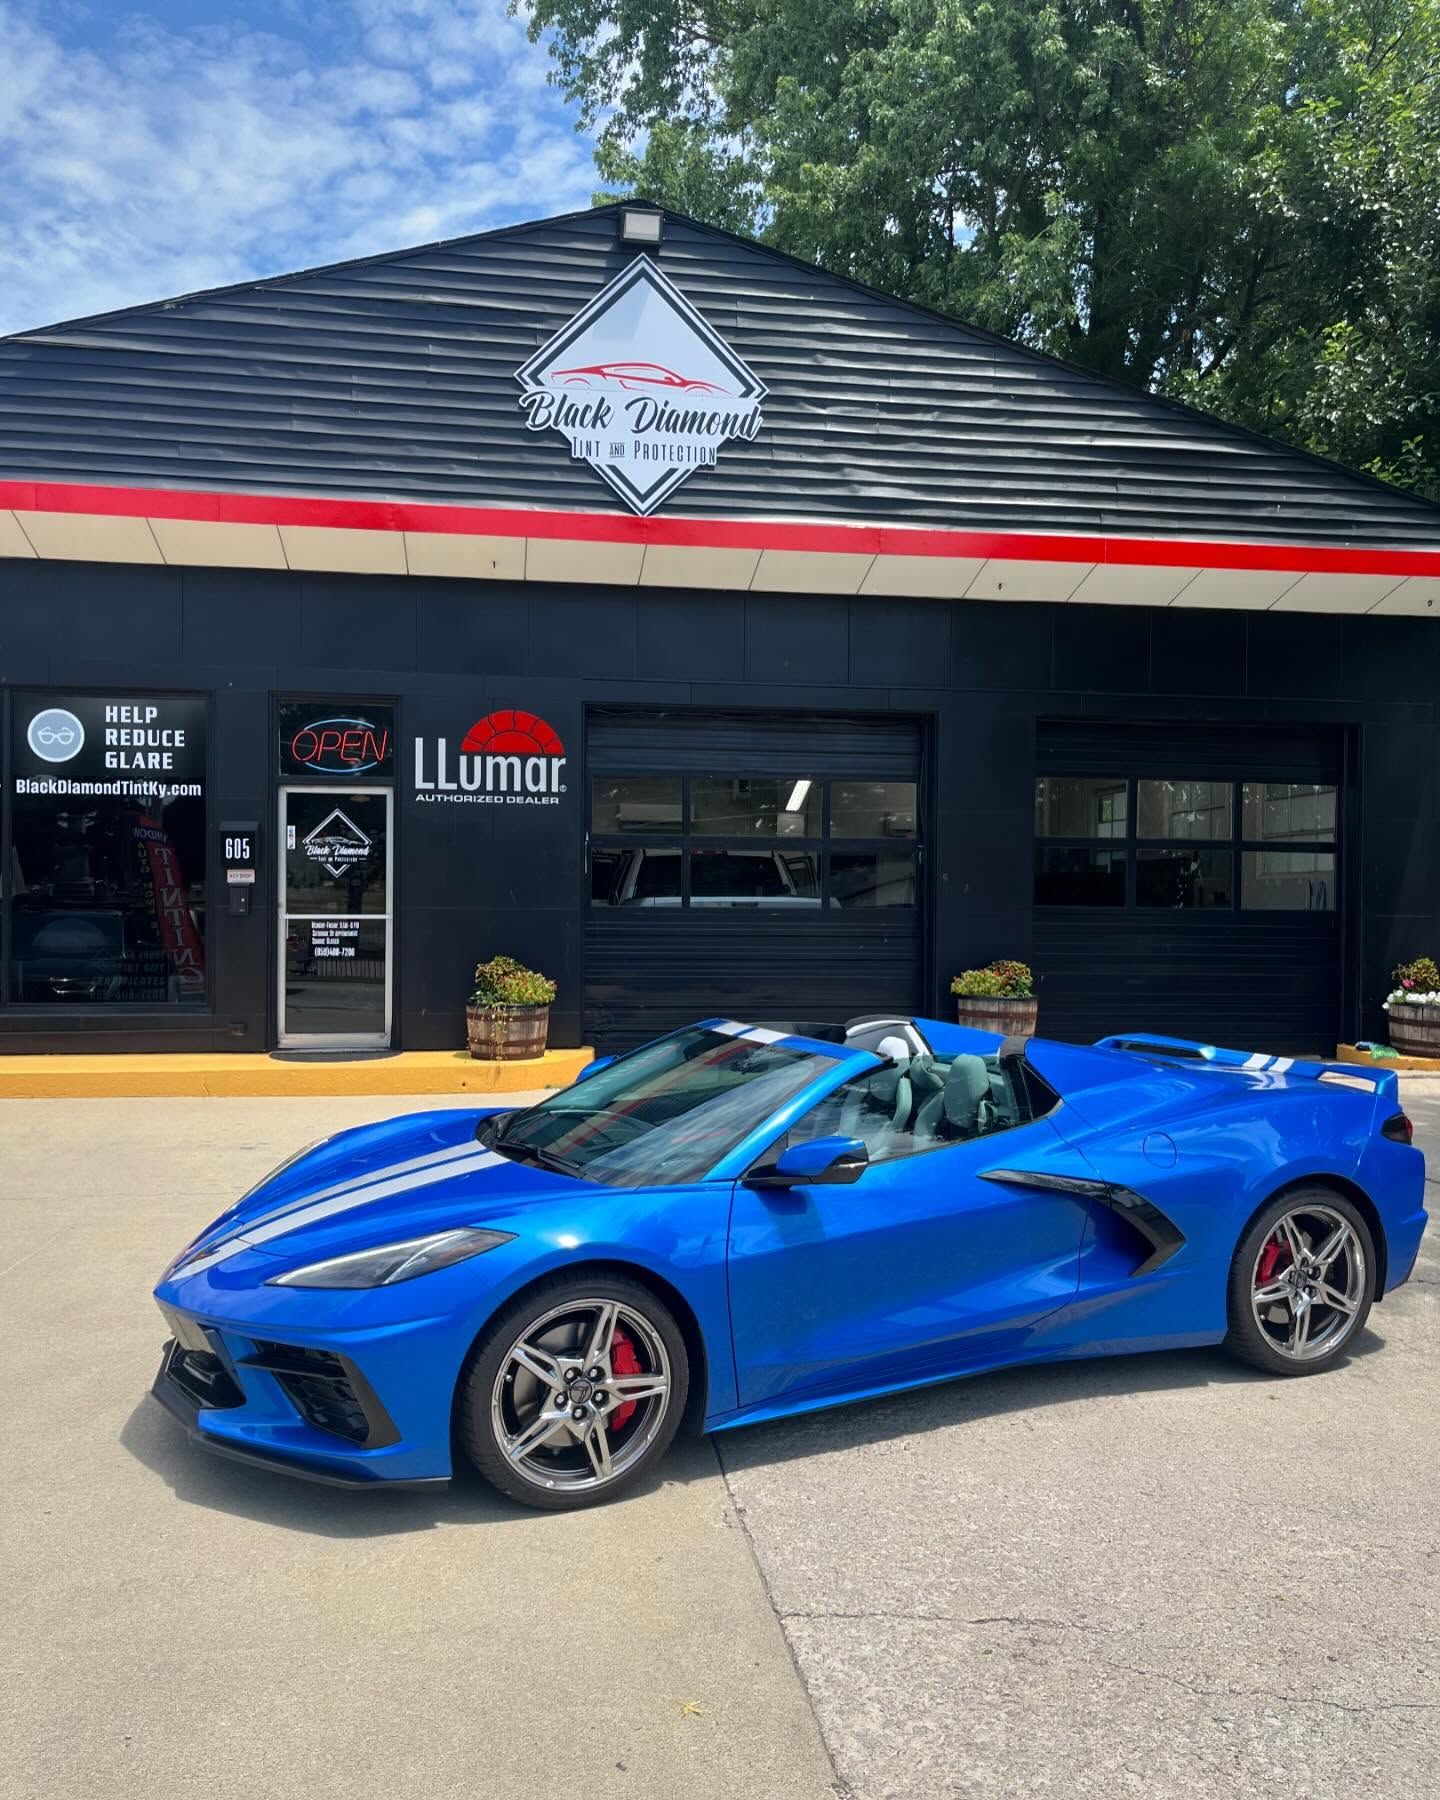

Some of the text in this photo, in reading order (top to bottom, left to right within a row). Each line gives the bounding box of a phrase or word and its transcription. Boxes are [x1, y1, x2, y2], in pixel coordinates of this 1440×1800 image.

[519, 390, 761, 438] Black Diamond
[572, 436, 716, 463] TINT AND PROTECTION
[105, 705, 158, 723] HELP
[105, 728, 185, 747] REDUCE
[292, 730, 388, 761] OPEN
[105, 751, 173, 769] GLARE
[16, 779, 202, 798] BlackDiamondTintKy.com
[415, 794, 559, 804] AUTHORIZED DEALER
[225, 838, 250, 859] 605
[304, 844, 369, 856] Black Diamond
